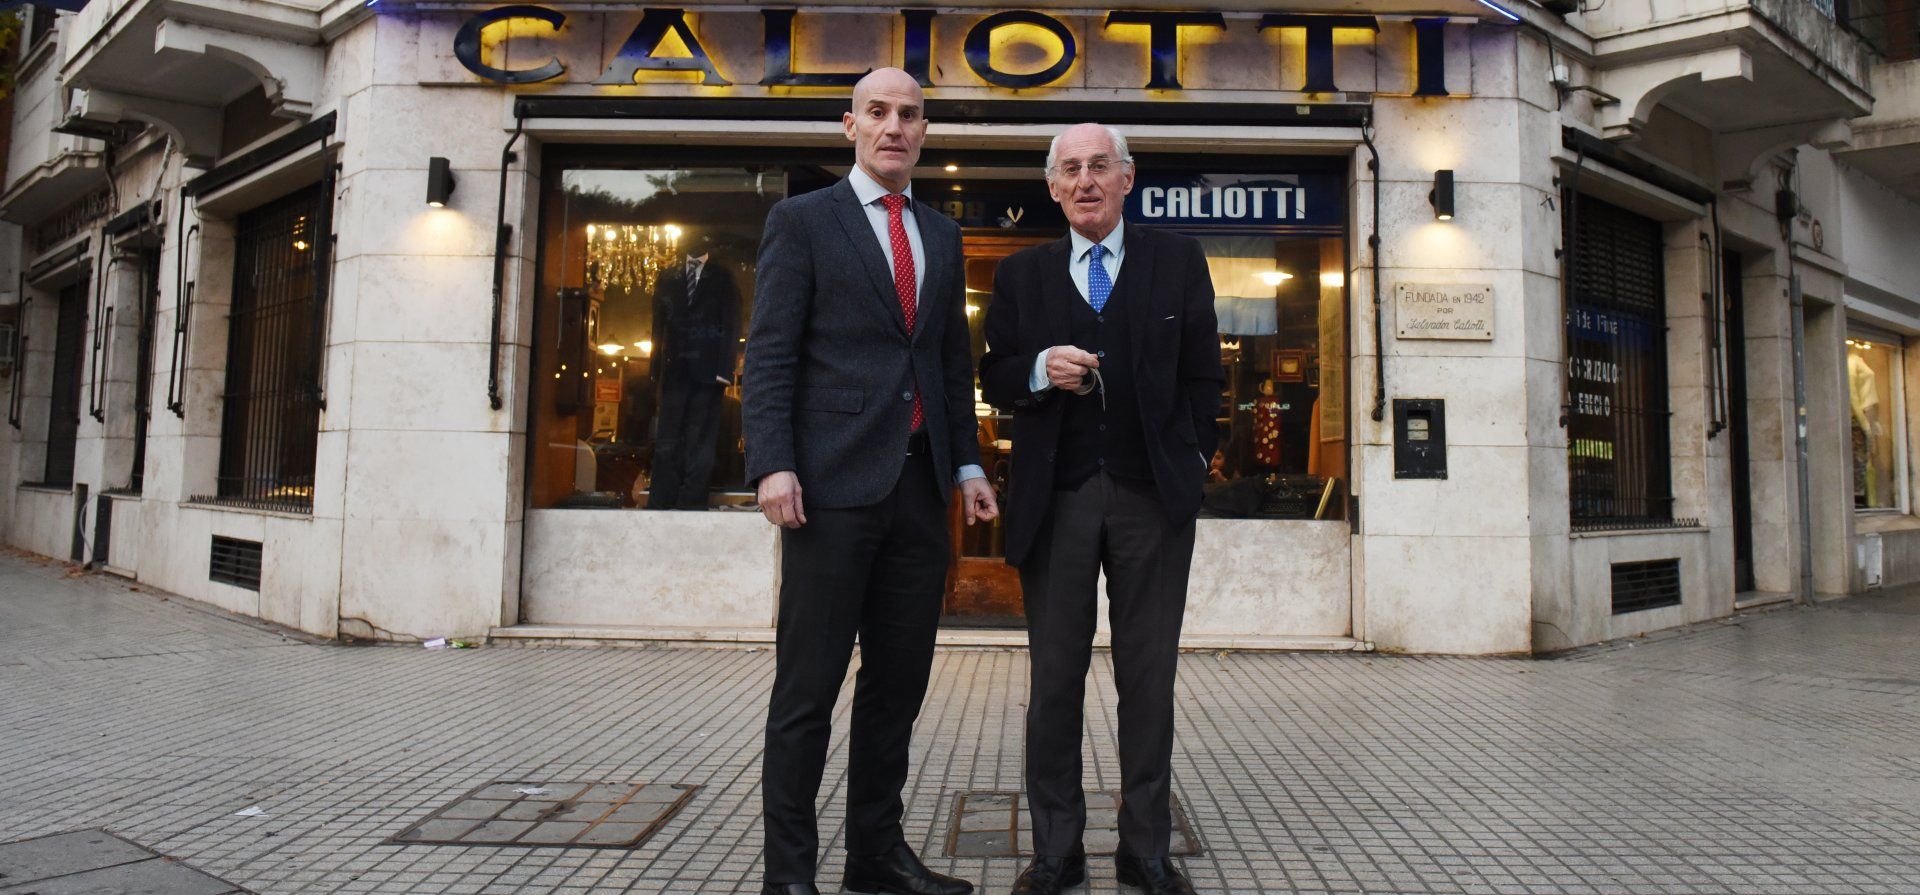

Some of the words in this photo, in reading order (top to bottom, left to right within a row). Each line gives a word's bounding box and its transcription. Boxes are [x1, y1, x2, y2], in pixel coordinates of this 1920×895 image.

[453, 5, 1450, 96] CALIOTTI
[1141, 186, 1306, 219] CALIOTTI
[1405, 291, 1449, 304] FUNDADA
[1452, 296, 1461, 304] EN
[1464, 292, 1485, 304] 1942
[1406, 318, 1450, 330] Salvador
[1453, 318, 1486, 331] Caliotti
